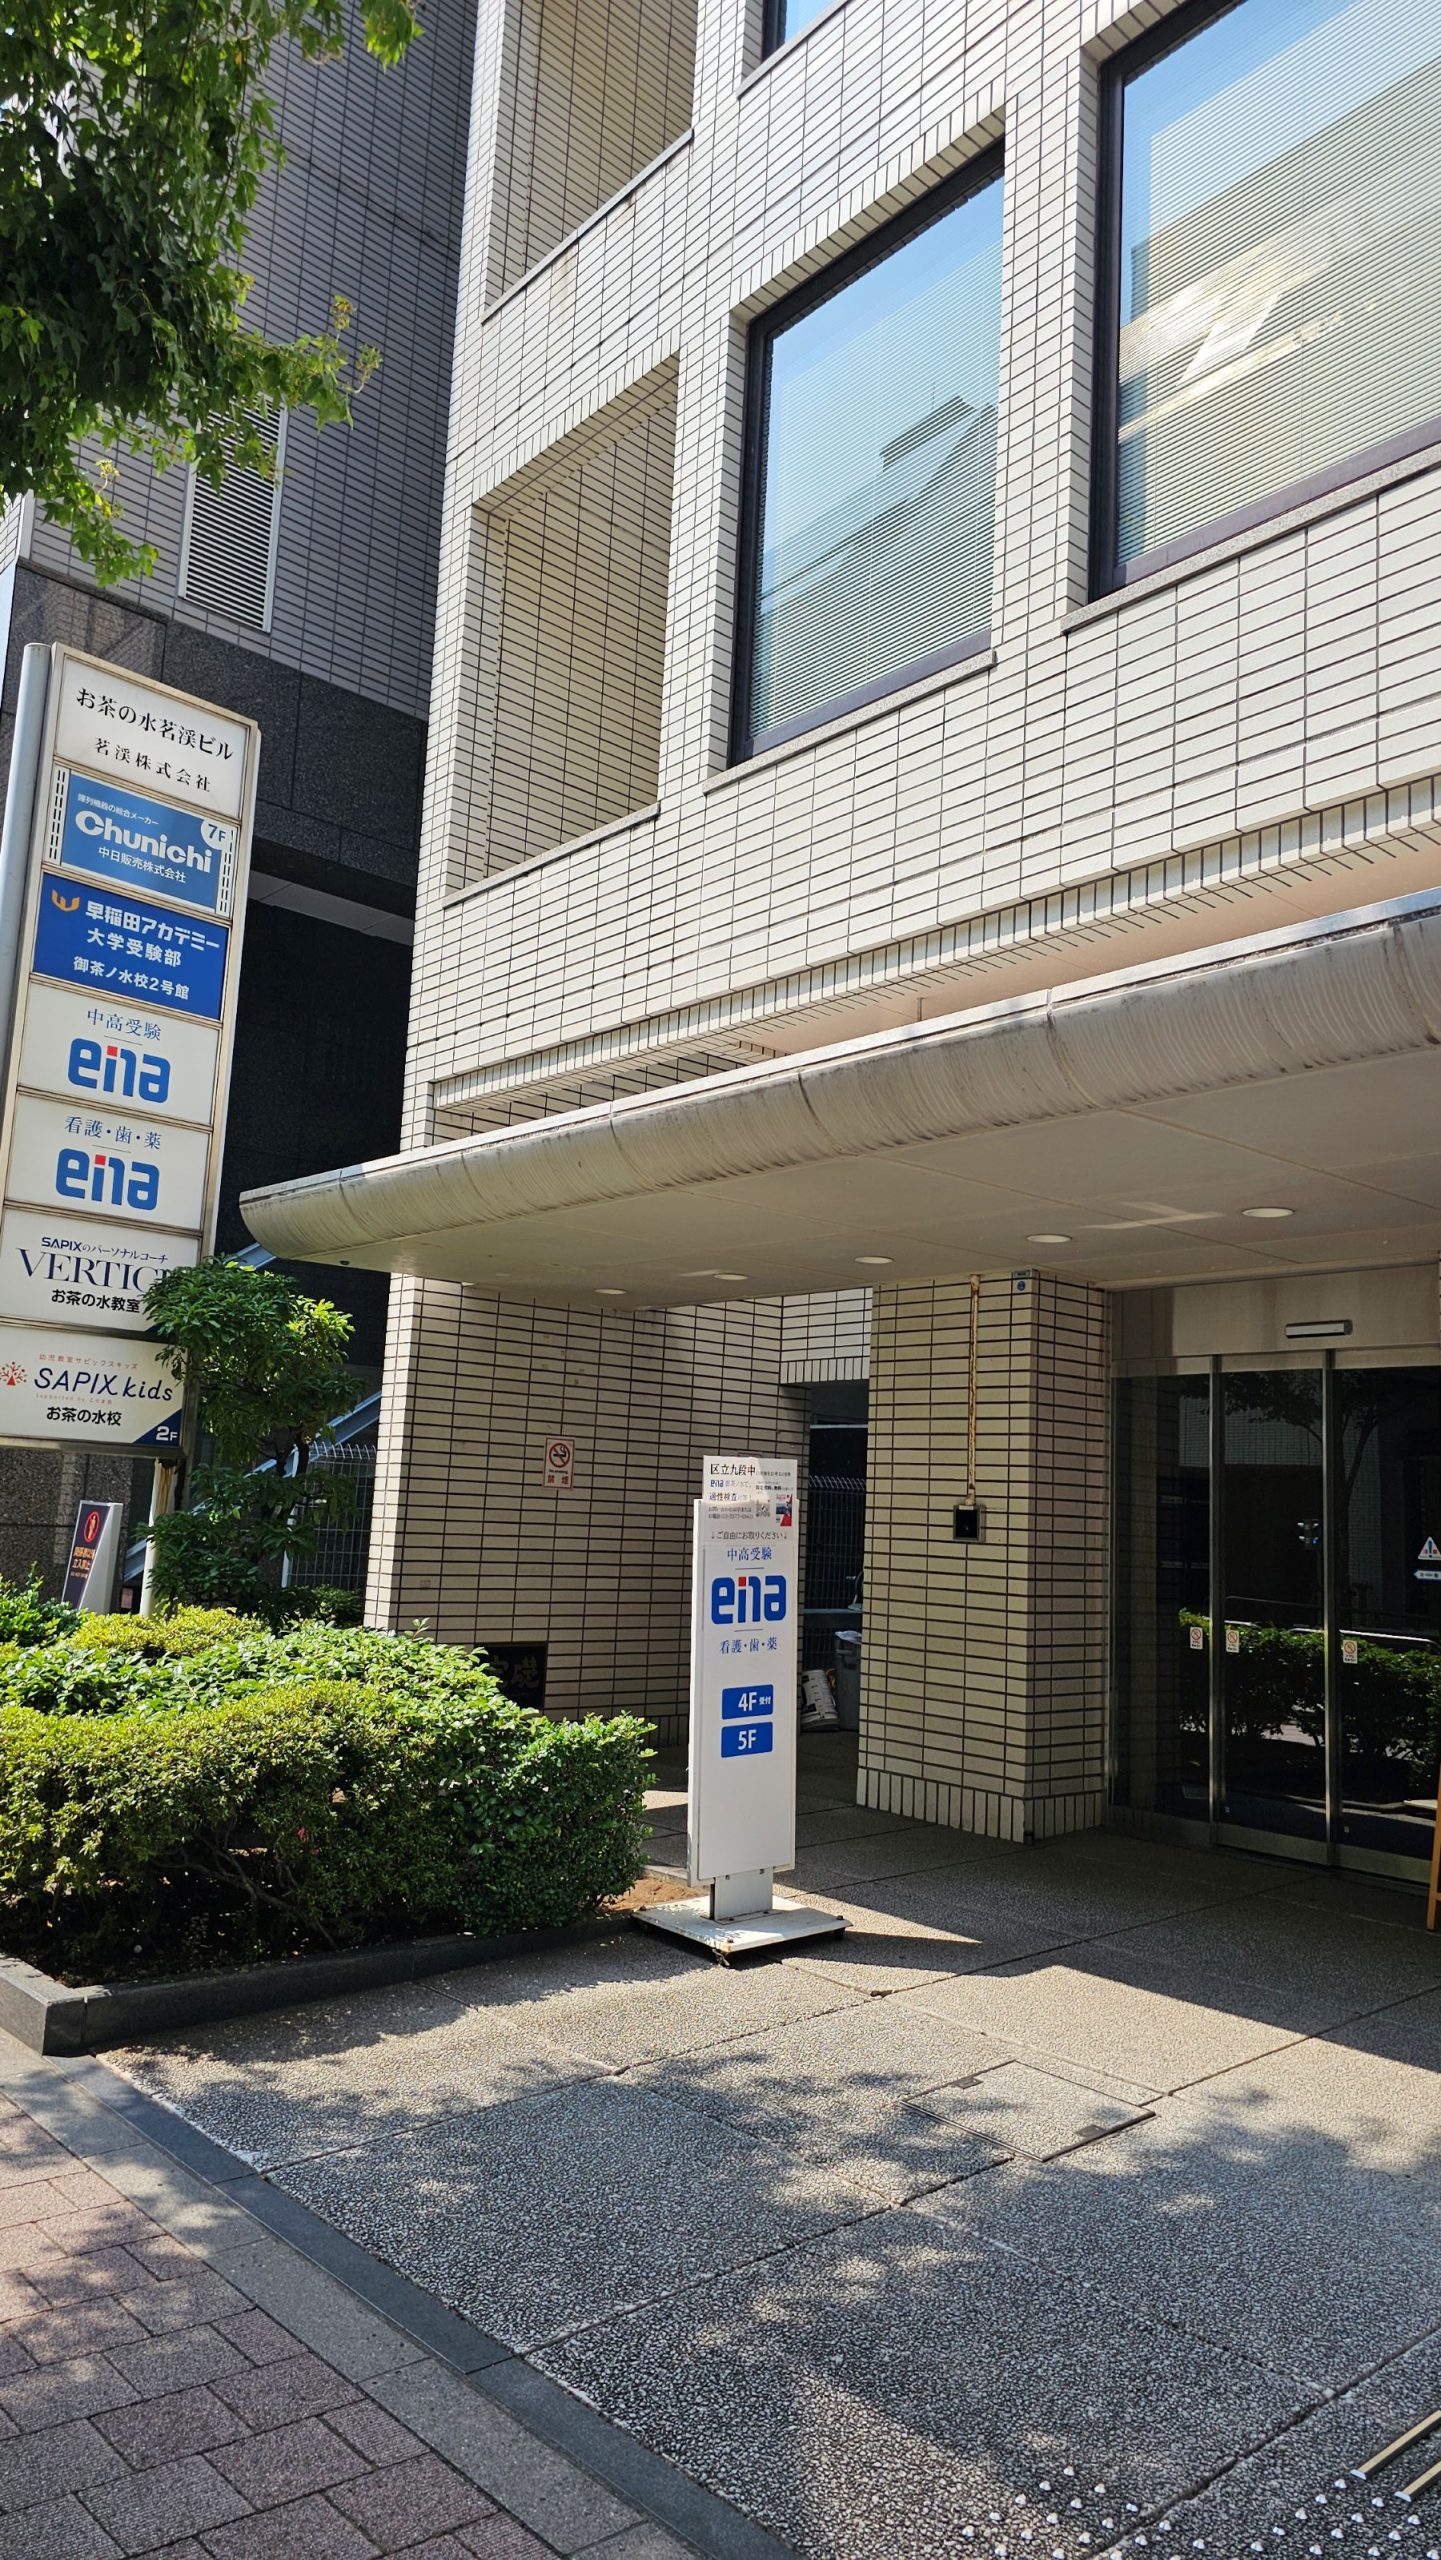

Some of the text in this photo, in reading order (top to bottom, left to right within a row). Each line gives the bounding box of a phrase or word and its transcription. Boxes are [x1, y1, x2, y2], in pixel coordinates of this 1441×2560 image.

[77, 687, 234, 761] お茶の水茗渓ビル
[95, 738, 211, 792] 茗渓株式会社
[75, 810, 213, 873] Chunichi
[208, 823, 226, 842] 7F
[98, 846, 187, 884] 中日販売株式会社
[85, 901, 220, 951] 早稲田アカデミー
[87, 928, 182, 967] 大学受験部
[73, 955, 190, 1001] 御茶ノ水校2号館
[86, 1008, 162, 1041] 中高受験
[67, 1037, 172, 1104] ena
[63, 1115, 161, 1150] 看護・歯・薬
[55, 1147, 160, 1211] ena
[16, 1247, 170, 1293] VERTIC
[51, 1289, 141, 1314] お茶の水教室
[34, 1367, 174, 1401] SAPIX kids
[46, 1406, 123, 1427] お茶の水校
[155, 1425, 178, 1441] 2F
[727, 1546, 772, 1561] 中高受験
[711, 1575, 787, 1625] ena
[720, 1636, 778, 1654] 看護・歯・薬
[738, 1691, 757, 1712] 4F
[738, 1729, 757, 1751] 5F
